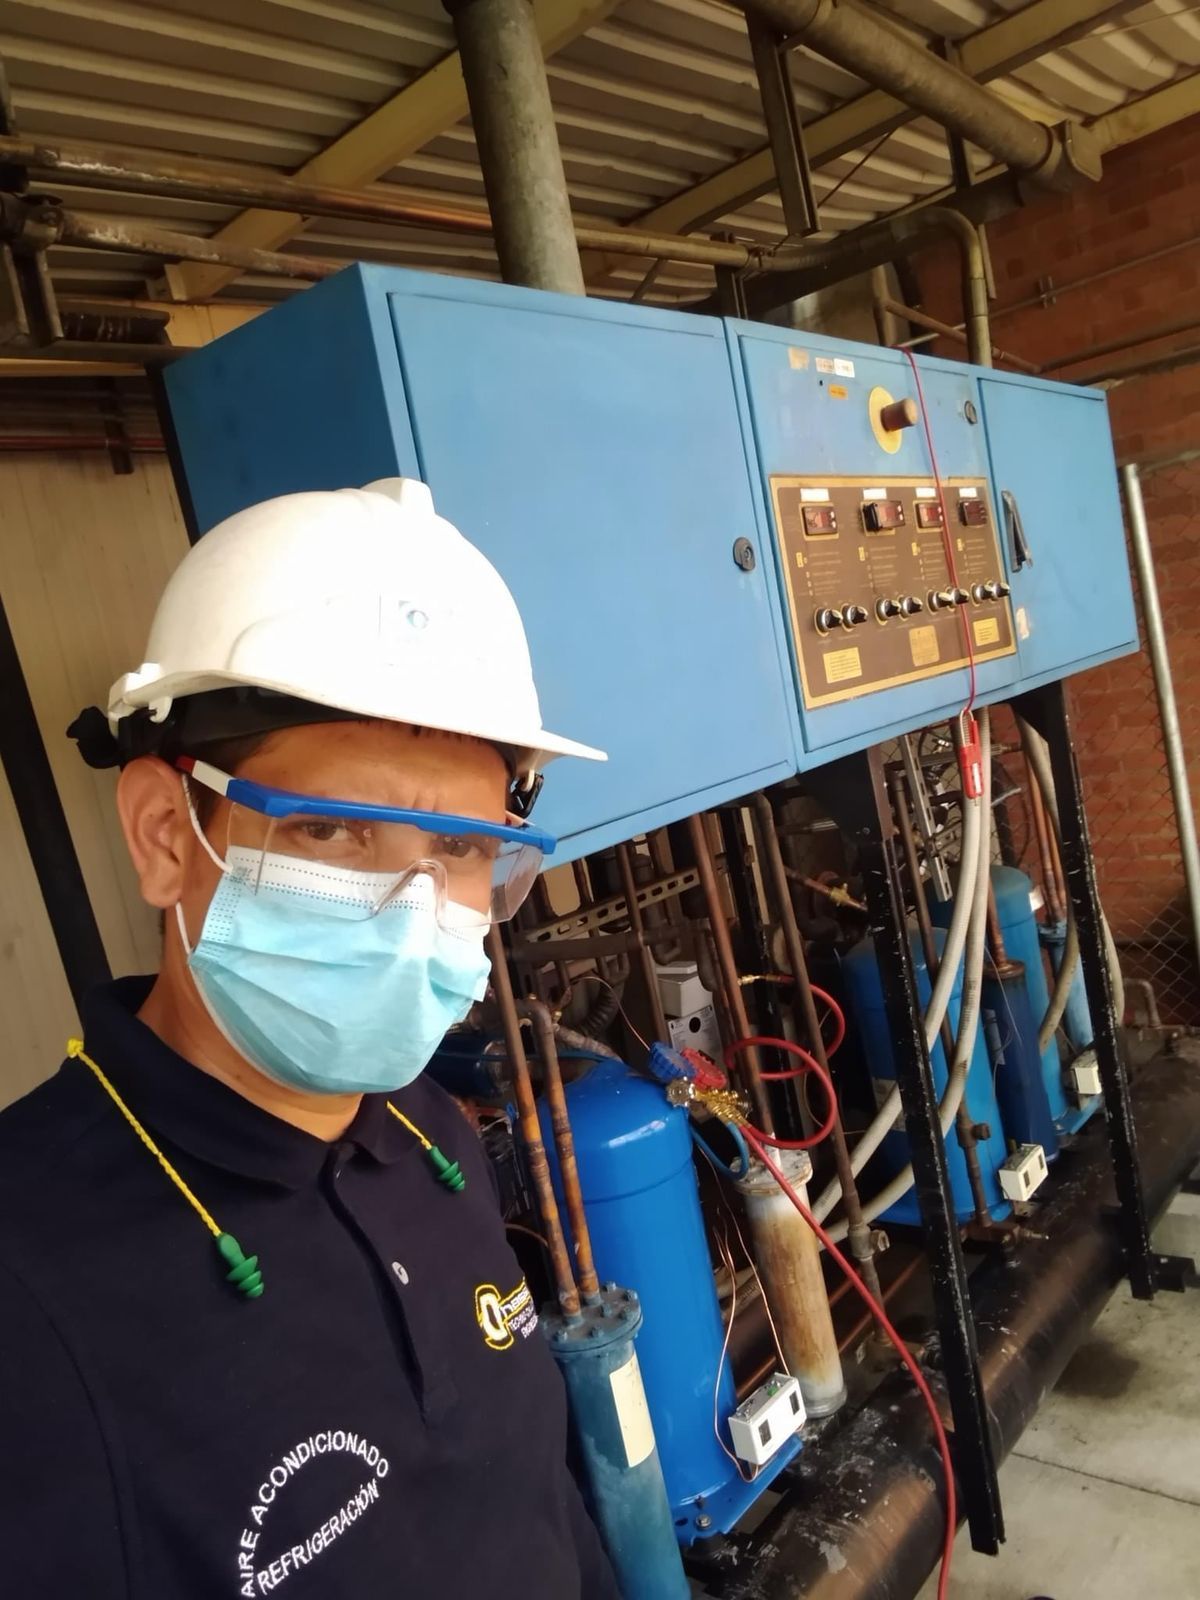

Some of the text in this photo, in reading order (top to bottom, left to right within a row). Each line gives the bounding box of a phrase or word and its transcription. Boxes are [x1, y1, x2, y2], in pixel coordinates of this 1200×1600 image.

[239, 1430, 389, 1598] AIRE ACONDICIONADO
[256, 1478, 380, 1596] REFRIGERACIÓN
